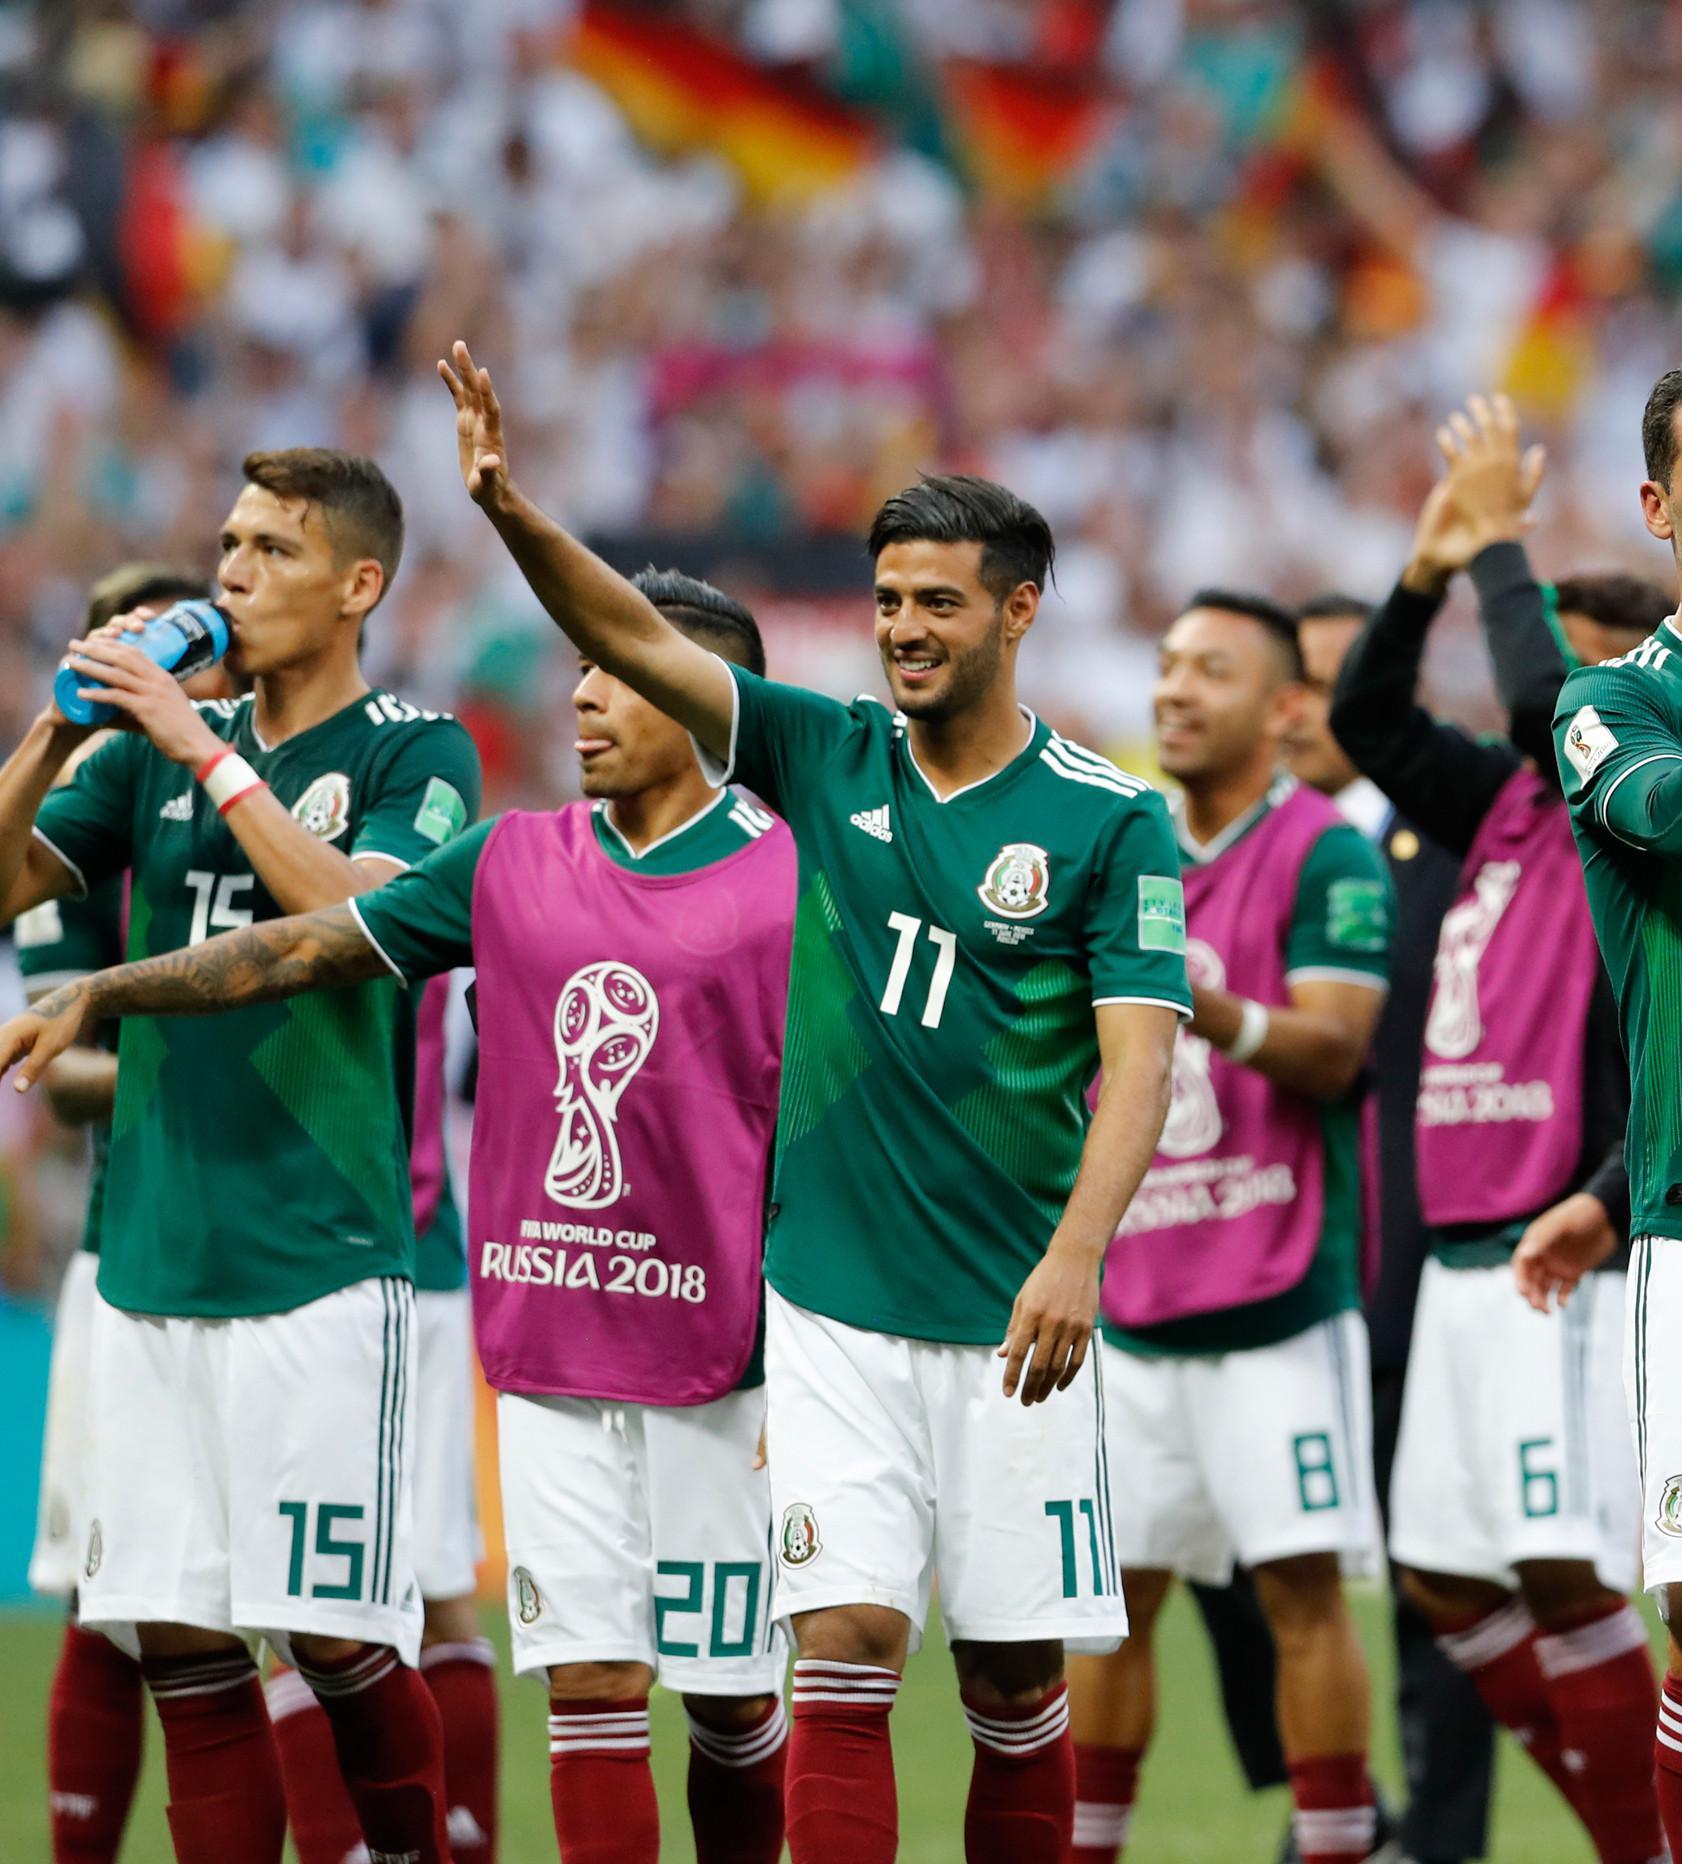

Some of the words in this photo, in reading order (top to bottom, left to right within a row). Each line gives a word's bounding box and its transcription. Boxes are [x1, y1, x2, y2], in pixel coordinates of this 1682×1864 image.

[850, 813, 893, 843] adidas
[185, 870, 255, 947] 15
[880, 911, 957, 1029] 11
[480, 1241, 600, 1291] RUSSIA
[604, 1255, 706, 1303] 2018
[542, 1222, 614, 1247] WORLD
[615, 1231, 656, 1252] CUP
[1293, 1432, 1339, 1512] 8
[1517, 1438, 1559, 1517] 6
[279, 1501, 365, 1601] 15
[1045, 1498, 1103, 1598] 11
[654, 1561, 761, 1657] 20
